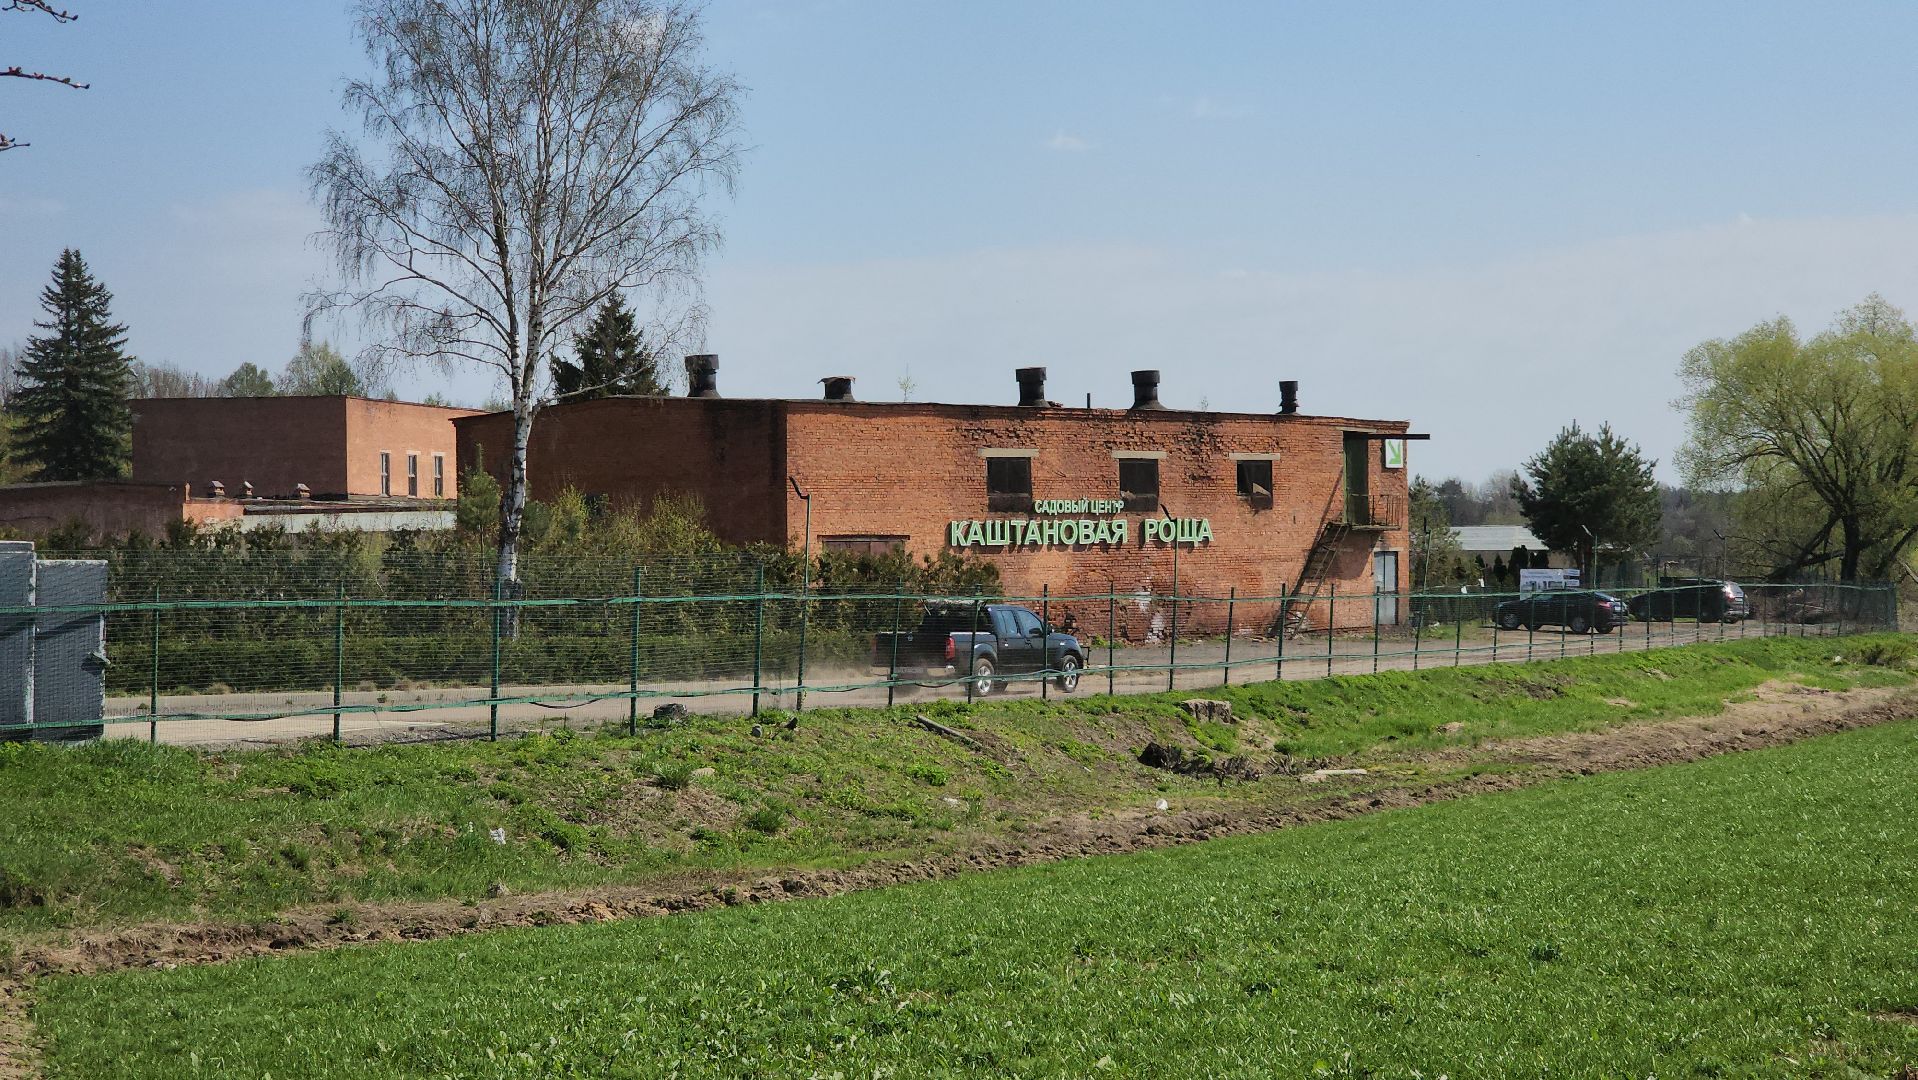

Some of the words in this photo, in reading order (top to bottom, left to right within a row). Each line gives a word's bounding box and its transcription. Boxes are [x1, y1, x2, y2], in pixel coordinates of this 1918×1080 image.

[1034, 496, 1089, 515] САДОВЫЙ
[1090, 500, 1125, 515] ЦЕНТР
[951, 519, 1128, 546] КАШТАНОВАЯ
[1144, 518, 1215, 547] РОЩА
